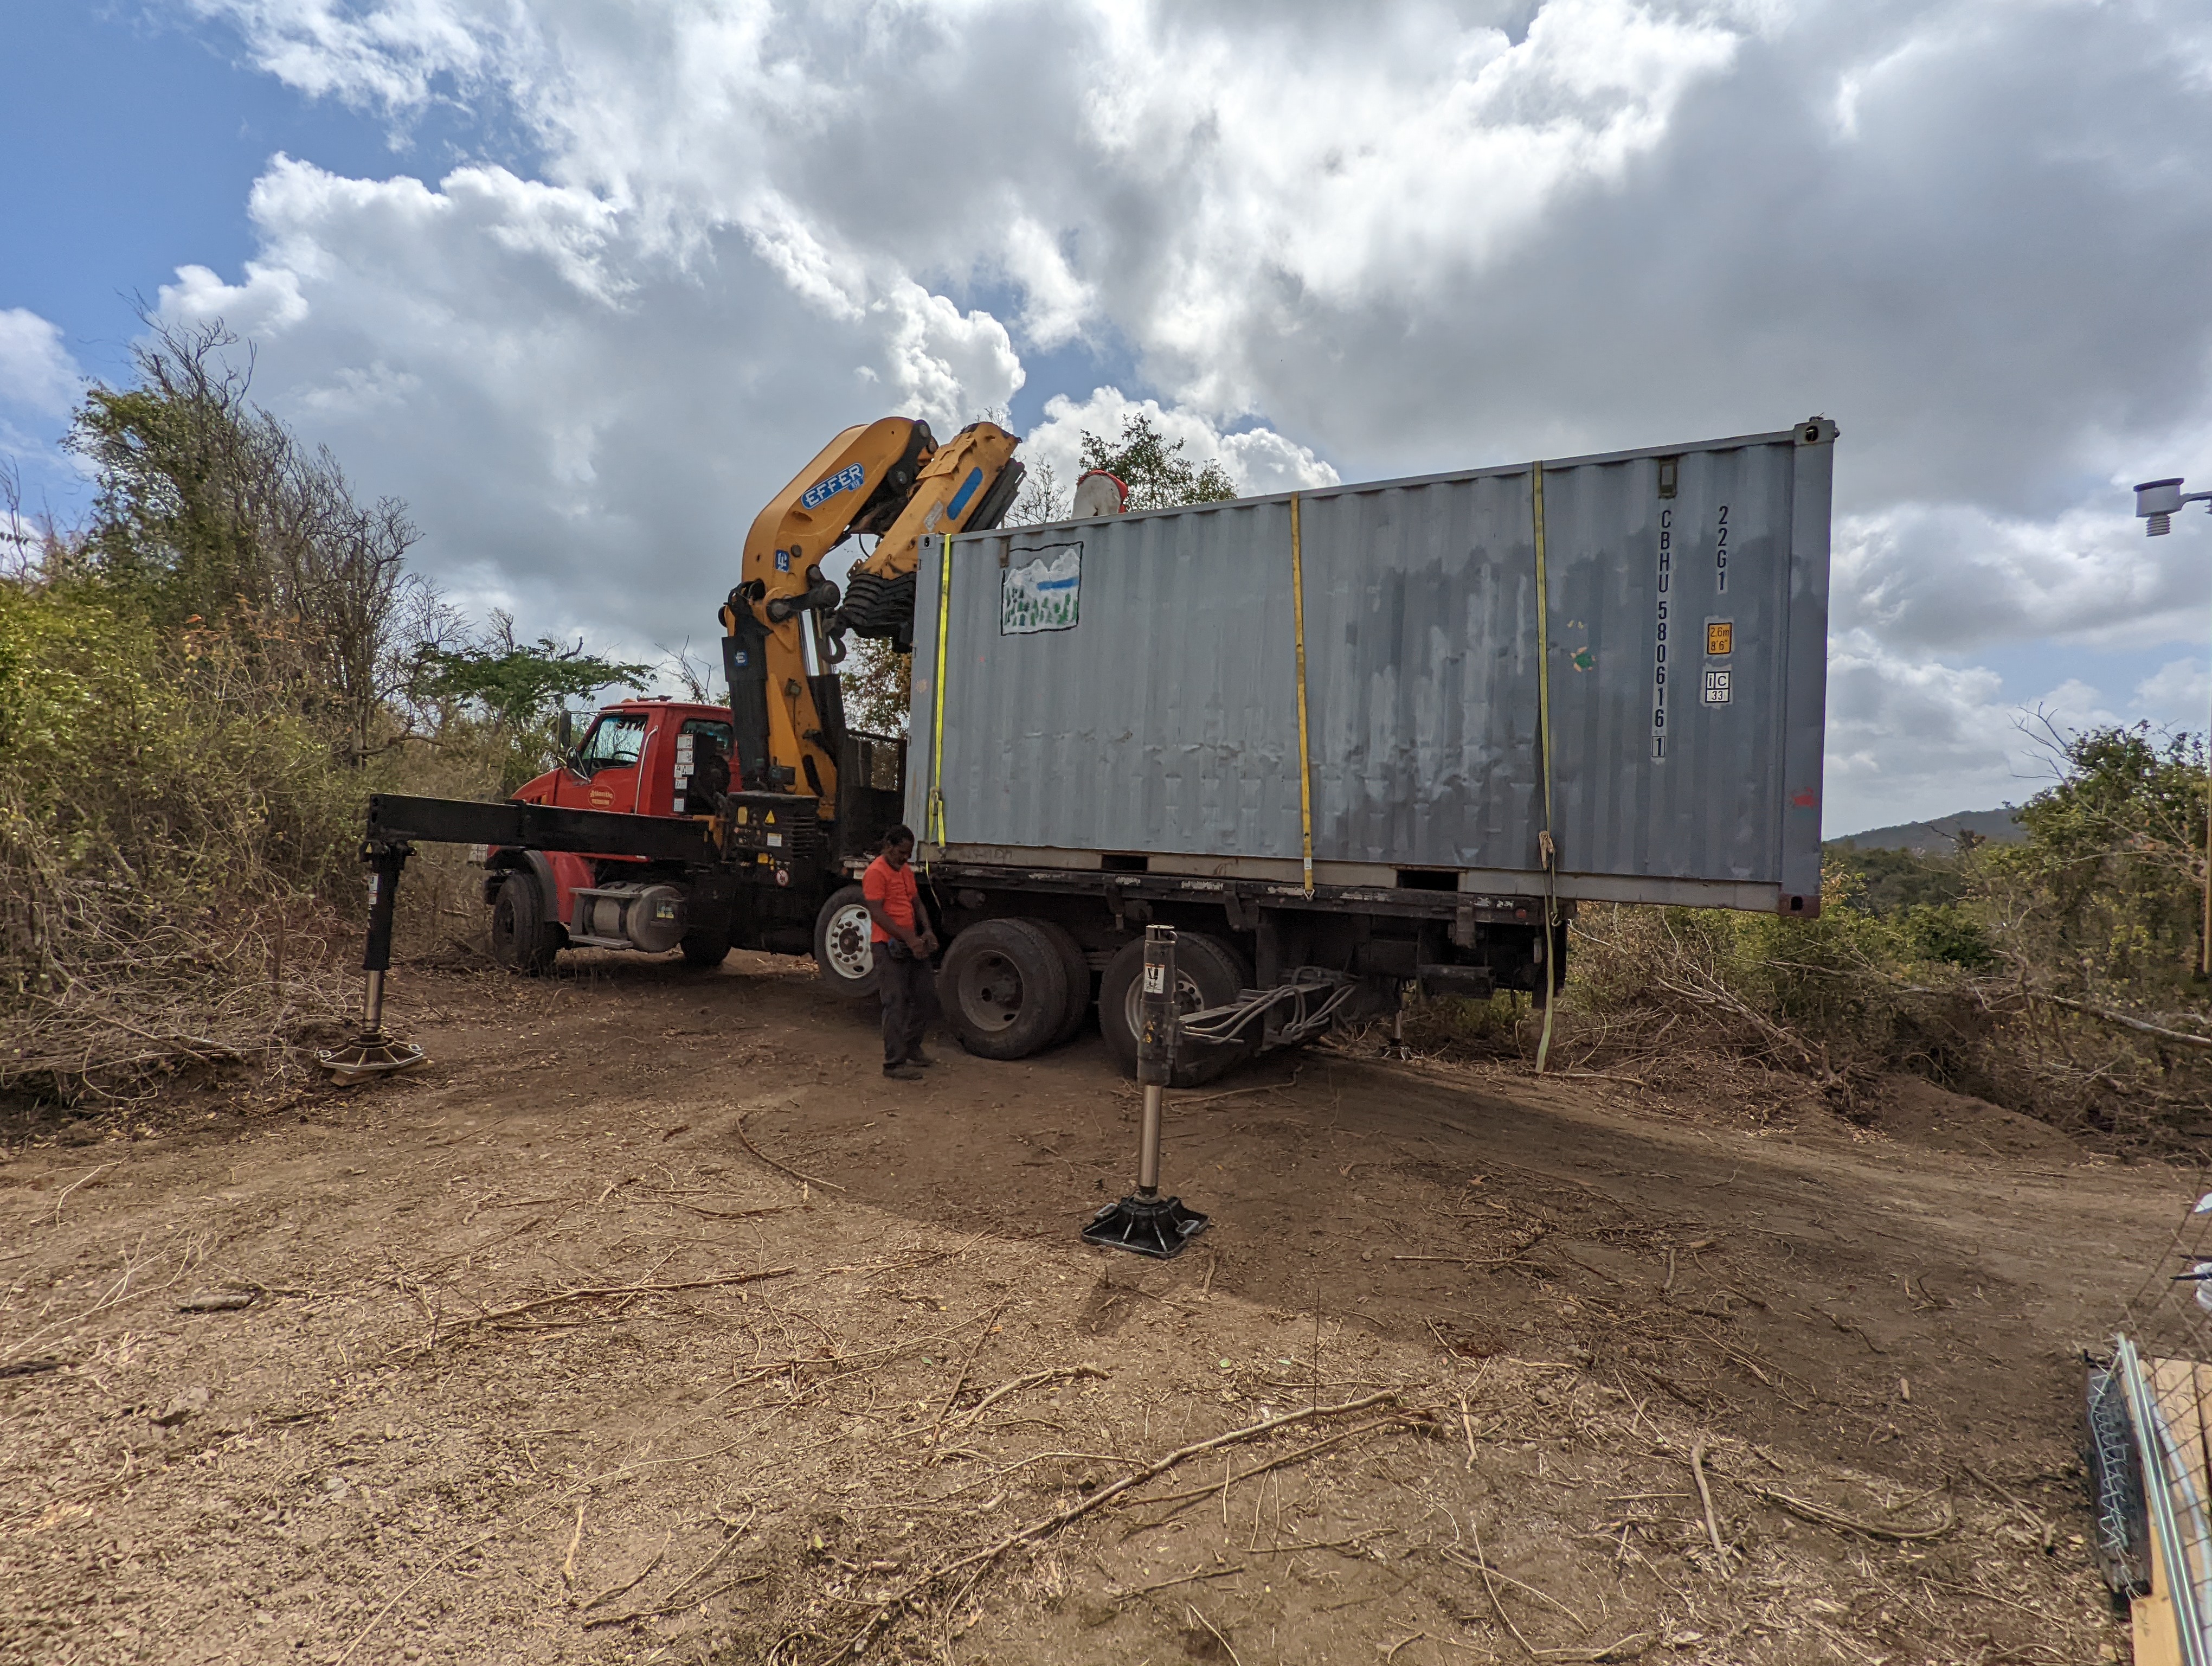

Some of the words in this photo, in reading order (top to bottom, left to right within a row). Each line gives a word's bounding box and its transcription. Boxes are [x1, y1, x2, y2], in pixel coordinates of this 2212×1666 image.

[805, 465, 862, 507] EFFER
[1658, 509, 1671, 593] CBHU
[1717, 505, 1728, 590] 22G1
[1710, 627, 1729, 637] 2.6m
[1655, 601, 1667, 727] 580616
[1712, 690, 1723, 700] 33
